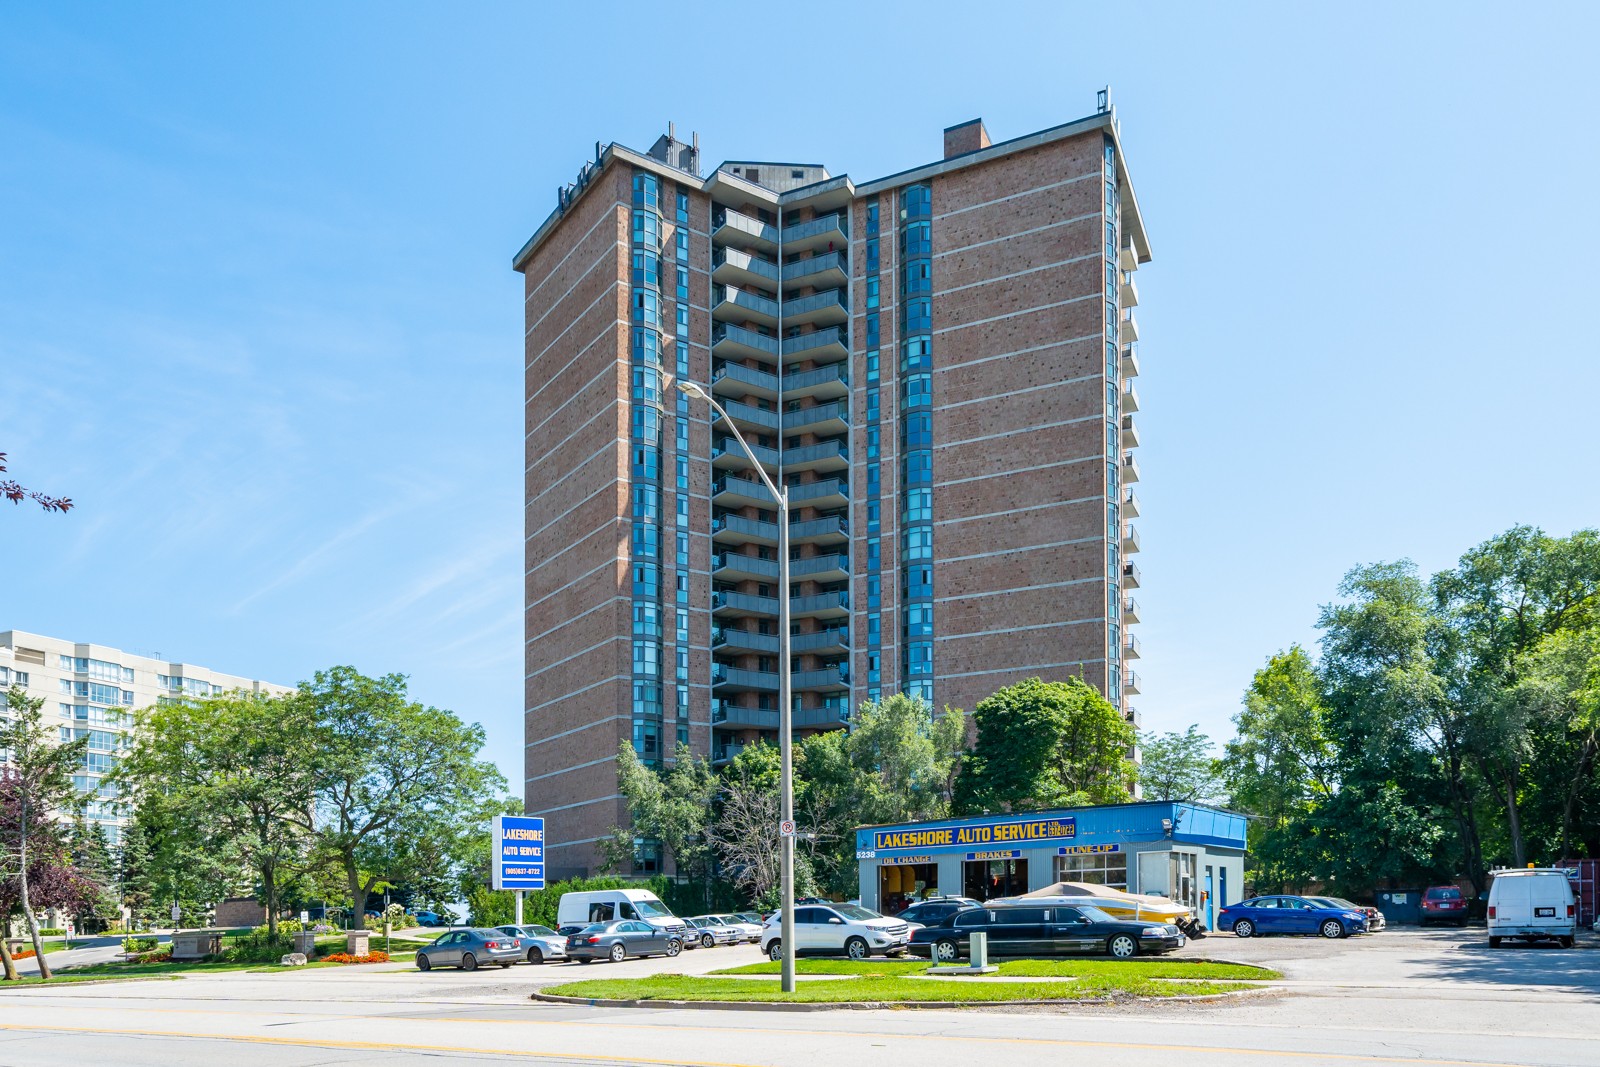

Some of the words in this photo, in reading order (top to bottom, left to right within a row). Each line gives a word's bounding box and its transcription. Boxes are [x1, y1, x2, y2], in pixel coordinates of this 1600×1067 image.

[502, 829, 542, 841] LAKESHORE
[877, 830, 953, 848] LAKESHORE
[956, 827, 991, 843] AUTO
[993, 821, 1047, 841] SERVICE
[503, 846, 518, 855] AUTO
[519, 847, 541, 856] SERVICE
[856, 851, 876, 859] 5238
[974, 850, 1012, 859] BRAKES
[1064, 845, 1114, 855] TUNE-UP
[883, 857, 897, 865] OIL
[897, 855, 931, 864] CHANGE
